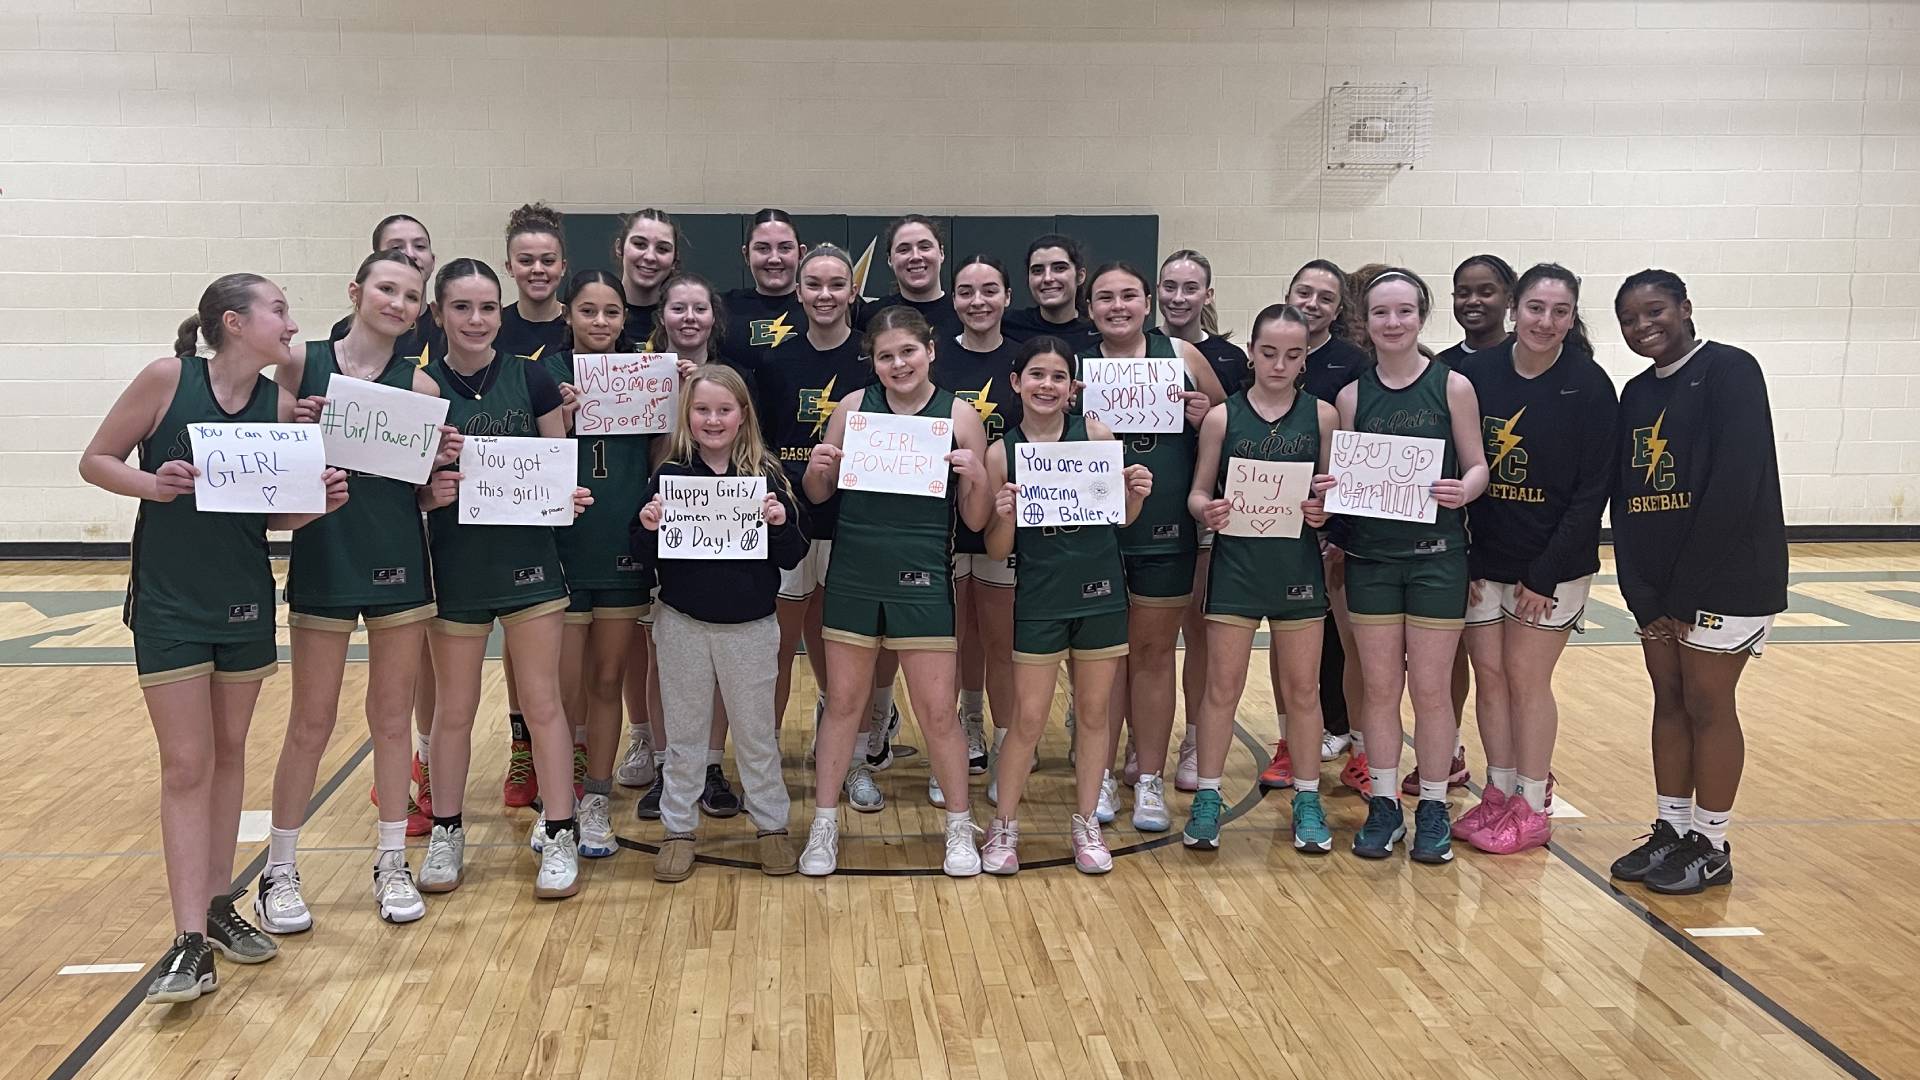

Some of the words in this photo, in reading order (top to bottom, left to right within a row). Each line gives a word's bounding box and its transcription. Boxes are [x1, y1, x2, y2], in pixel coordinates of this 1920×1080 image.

[1089, 360, 1176, 384] WOMEN'S
[616, 393, 632, 404] In
[1100, 384, 1156, 412] SPORTS
[582, 400, 667, 432] Sports
[869, 430, 921, 452] GIRL
[206, 450, 289, 488] GIRL
[477, 444, 505, 468] You
[513, 454, 542, 480] got
[593, 440, 607, 478] 1
[850, 451, 933, 475] POWER!
[1021, 447, 1052, 471] You
[1057, 458, 1083, 473] are
[1088, 460, 1109, 473] an
[1388, 445, 1433, 484] go
[476, 480, 504, 497] this
[513, 484, 550, 505] girl!!
[664, 480, 709, 507] Happy
[1236, 464, 1284, 500] Slay
[1020, 484, 1079, 508] amazing
[1231, 494, 1293, 515] Queens
[664, 509, 711, 523] Women
[716, 510, 727, 521] in
[733, 506, 765, 529] Sports
[1058, 506, 1104, 522] Baller
[692, 526, 731, 555] Day!
